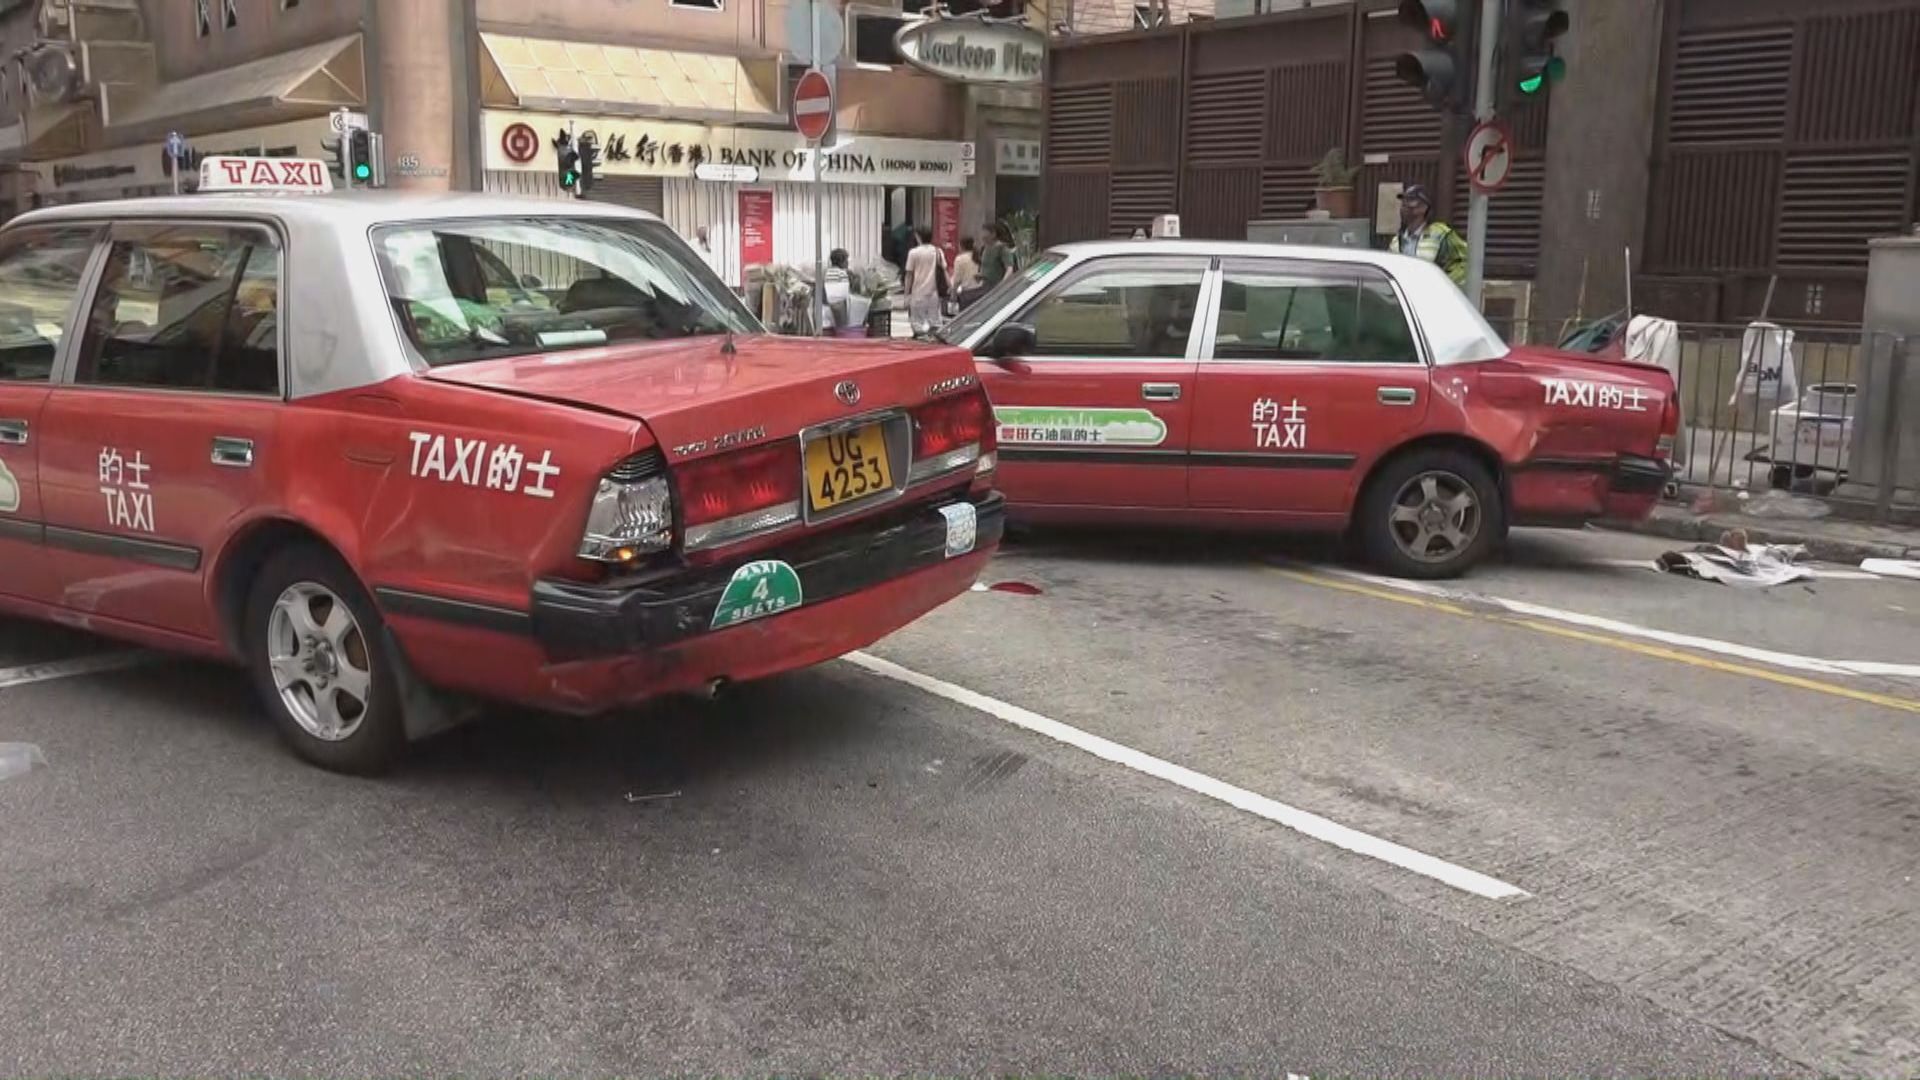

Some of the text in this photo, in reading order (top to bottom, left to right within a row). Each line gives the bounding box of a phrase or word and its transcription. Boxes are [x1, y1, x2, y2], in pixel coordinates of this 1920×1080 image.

[220, 160, 323, 185] TAXI
[721, 148, 777, 166] BANK
[782, 151, 808, 171] OF
[818, 153, 876, 173] HINA
[1253, 397, 1308, 423] 的士
[1251, 422, 1306, 448] TAXI
[827, 431, 863, 466] UG
[99, 446, 151, 489] 的士
[820, 456, 884, 503] 4253
[100, 486, 155, 532] TAXI
[752, 576, 769, 600] 4
[731, 595, 786, 620] SEATS
